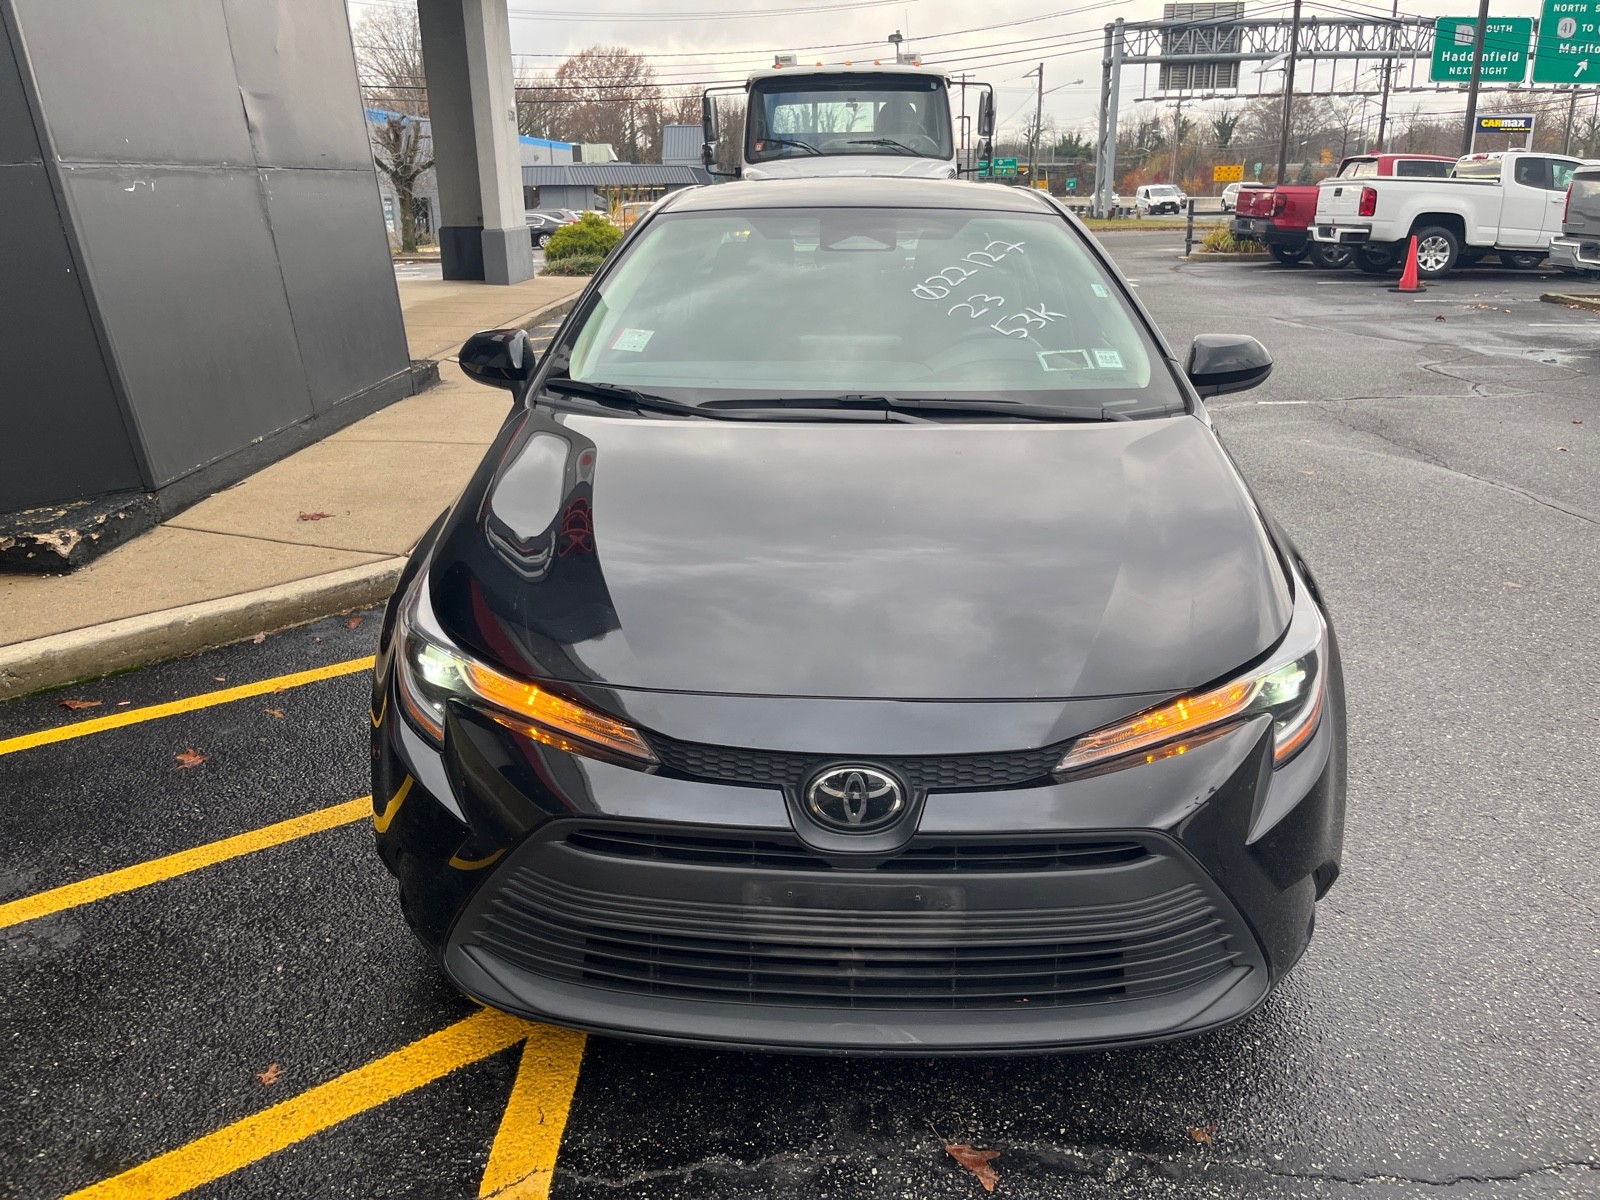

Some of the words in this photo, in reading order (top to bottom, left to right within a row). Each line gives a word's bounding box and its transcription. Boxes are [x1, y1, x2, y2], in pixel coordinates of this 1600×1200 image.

[1553, 4, 1587, 12] NORTH
[1485, 25, 1513, 33] OUTH
[1560, 22, 1573, 34] 41
[1582, 24, 1594, 32] TO
[1441, 51, 1519, 62] Haddnfield
[1449, 67, 1473, 75] NEXT
[947, 293, 1004, 318] 23
